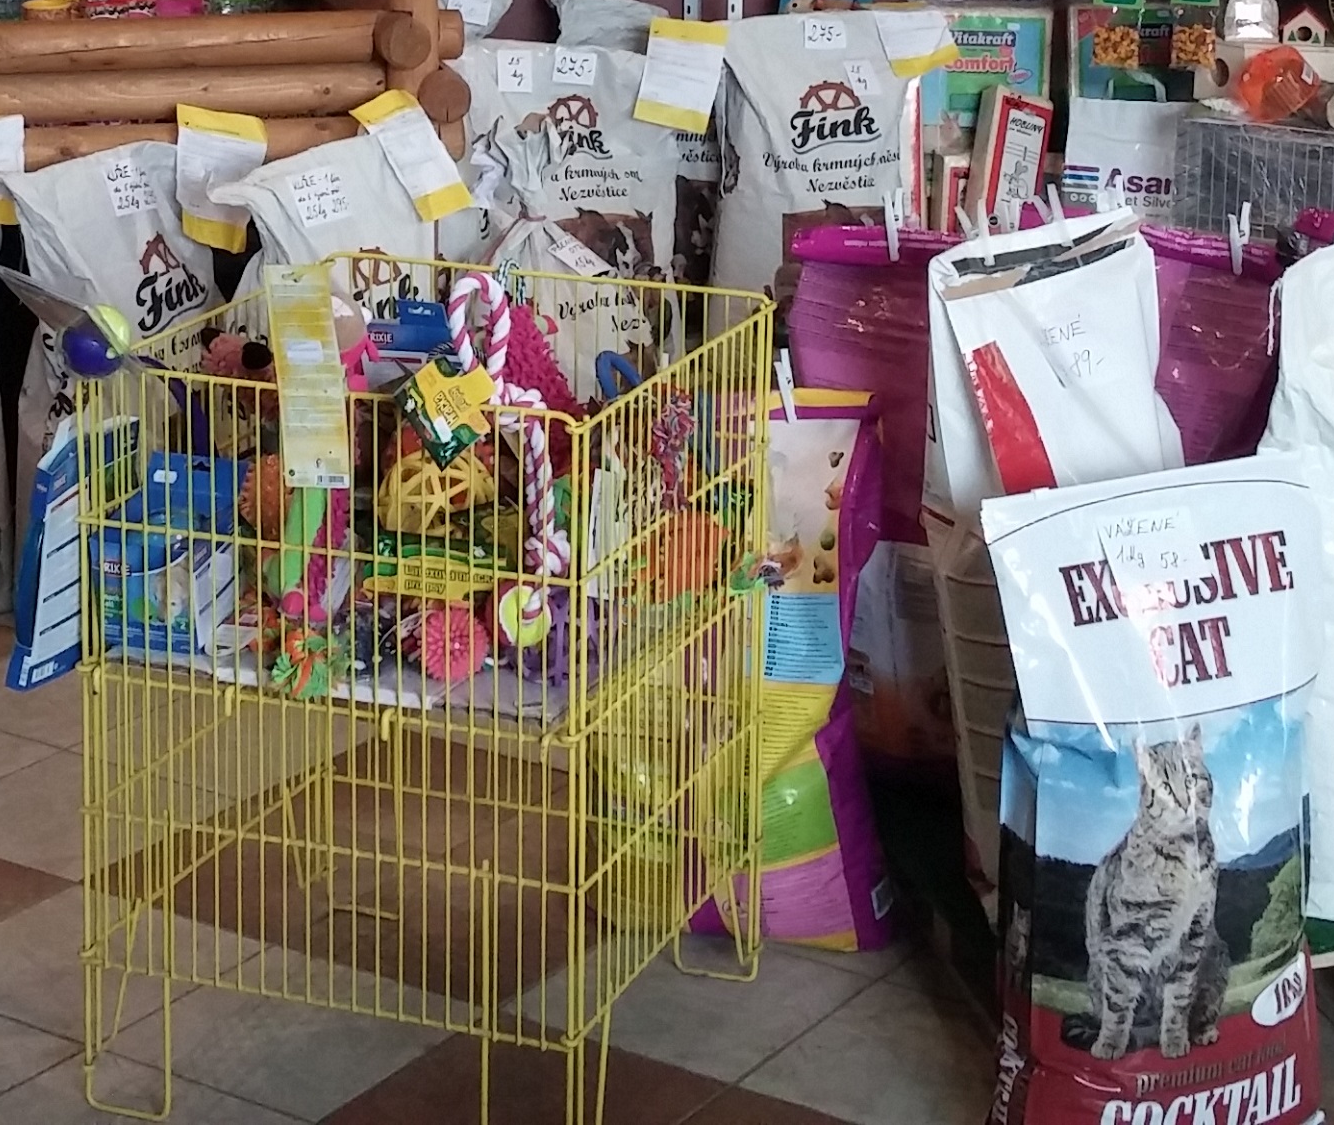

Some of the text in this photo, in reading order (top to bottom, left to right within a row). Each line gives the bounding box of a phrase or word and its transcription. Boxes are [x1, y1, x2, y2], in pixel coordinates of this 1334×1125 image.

[560, 125, 610, 156] ink
[790, 106, 880, 149] Fink
[559, 185, 629, 203] Nezvěstice
[135, 263, 208, 333] Fink
[1149, 615, 1233, 691] CAT
[1100, 1053, 1302, 1125] COCKTAIL
